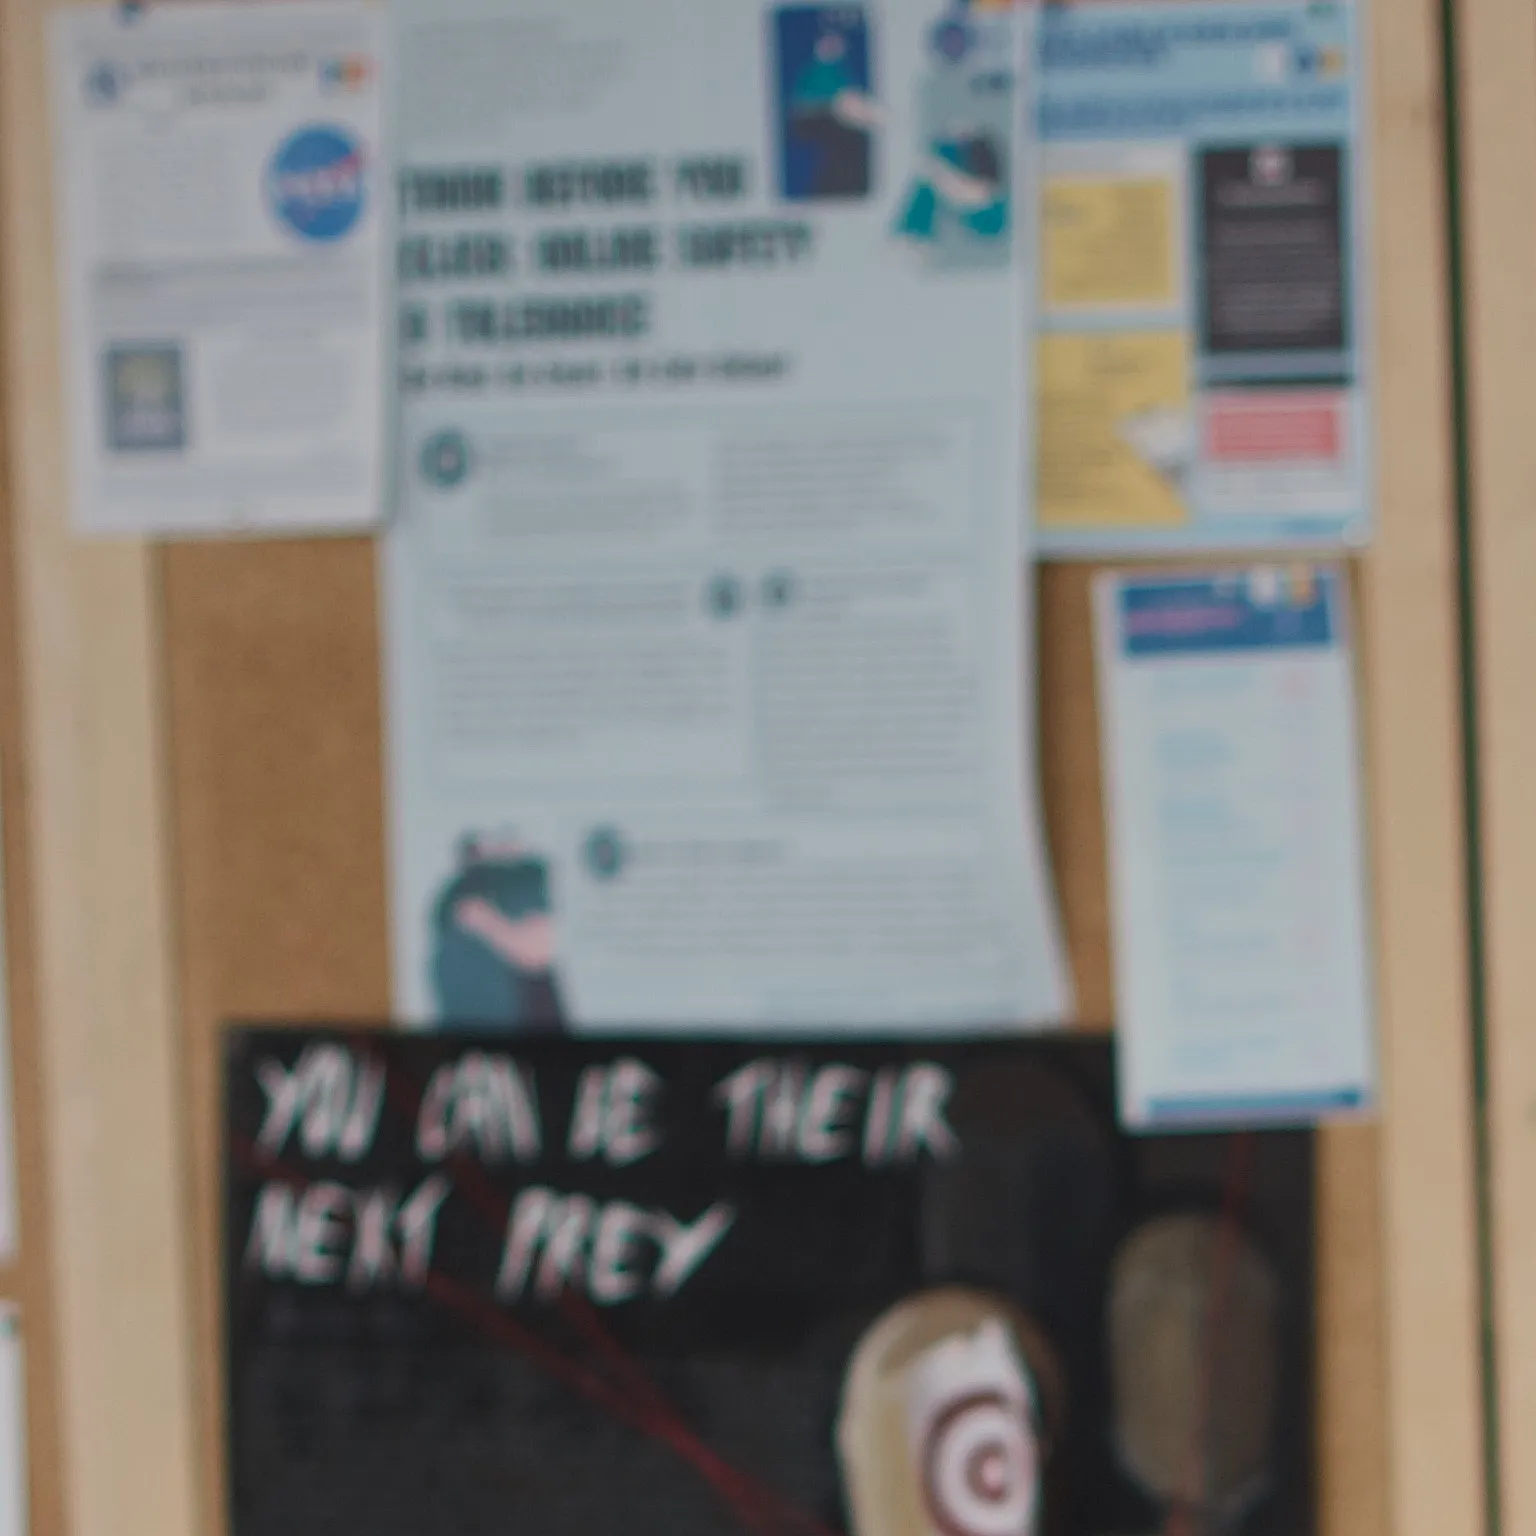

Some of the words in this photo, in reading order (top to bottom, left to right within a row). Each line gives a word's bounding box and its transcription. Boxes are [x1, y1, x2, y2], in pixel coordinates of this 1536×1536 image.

[254, 1043, 387, 1163] YOU
[413, 1049, 541, 1163] CAN
[566, 1056, 666, 1165] BE
[712, 1053, 963, 1168] THEIR
[246, 1176, 453, 1292] NEXT
[495, 1185, 736, 1306] PREY
